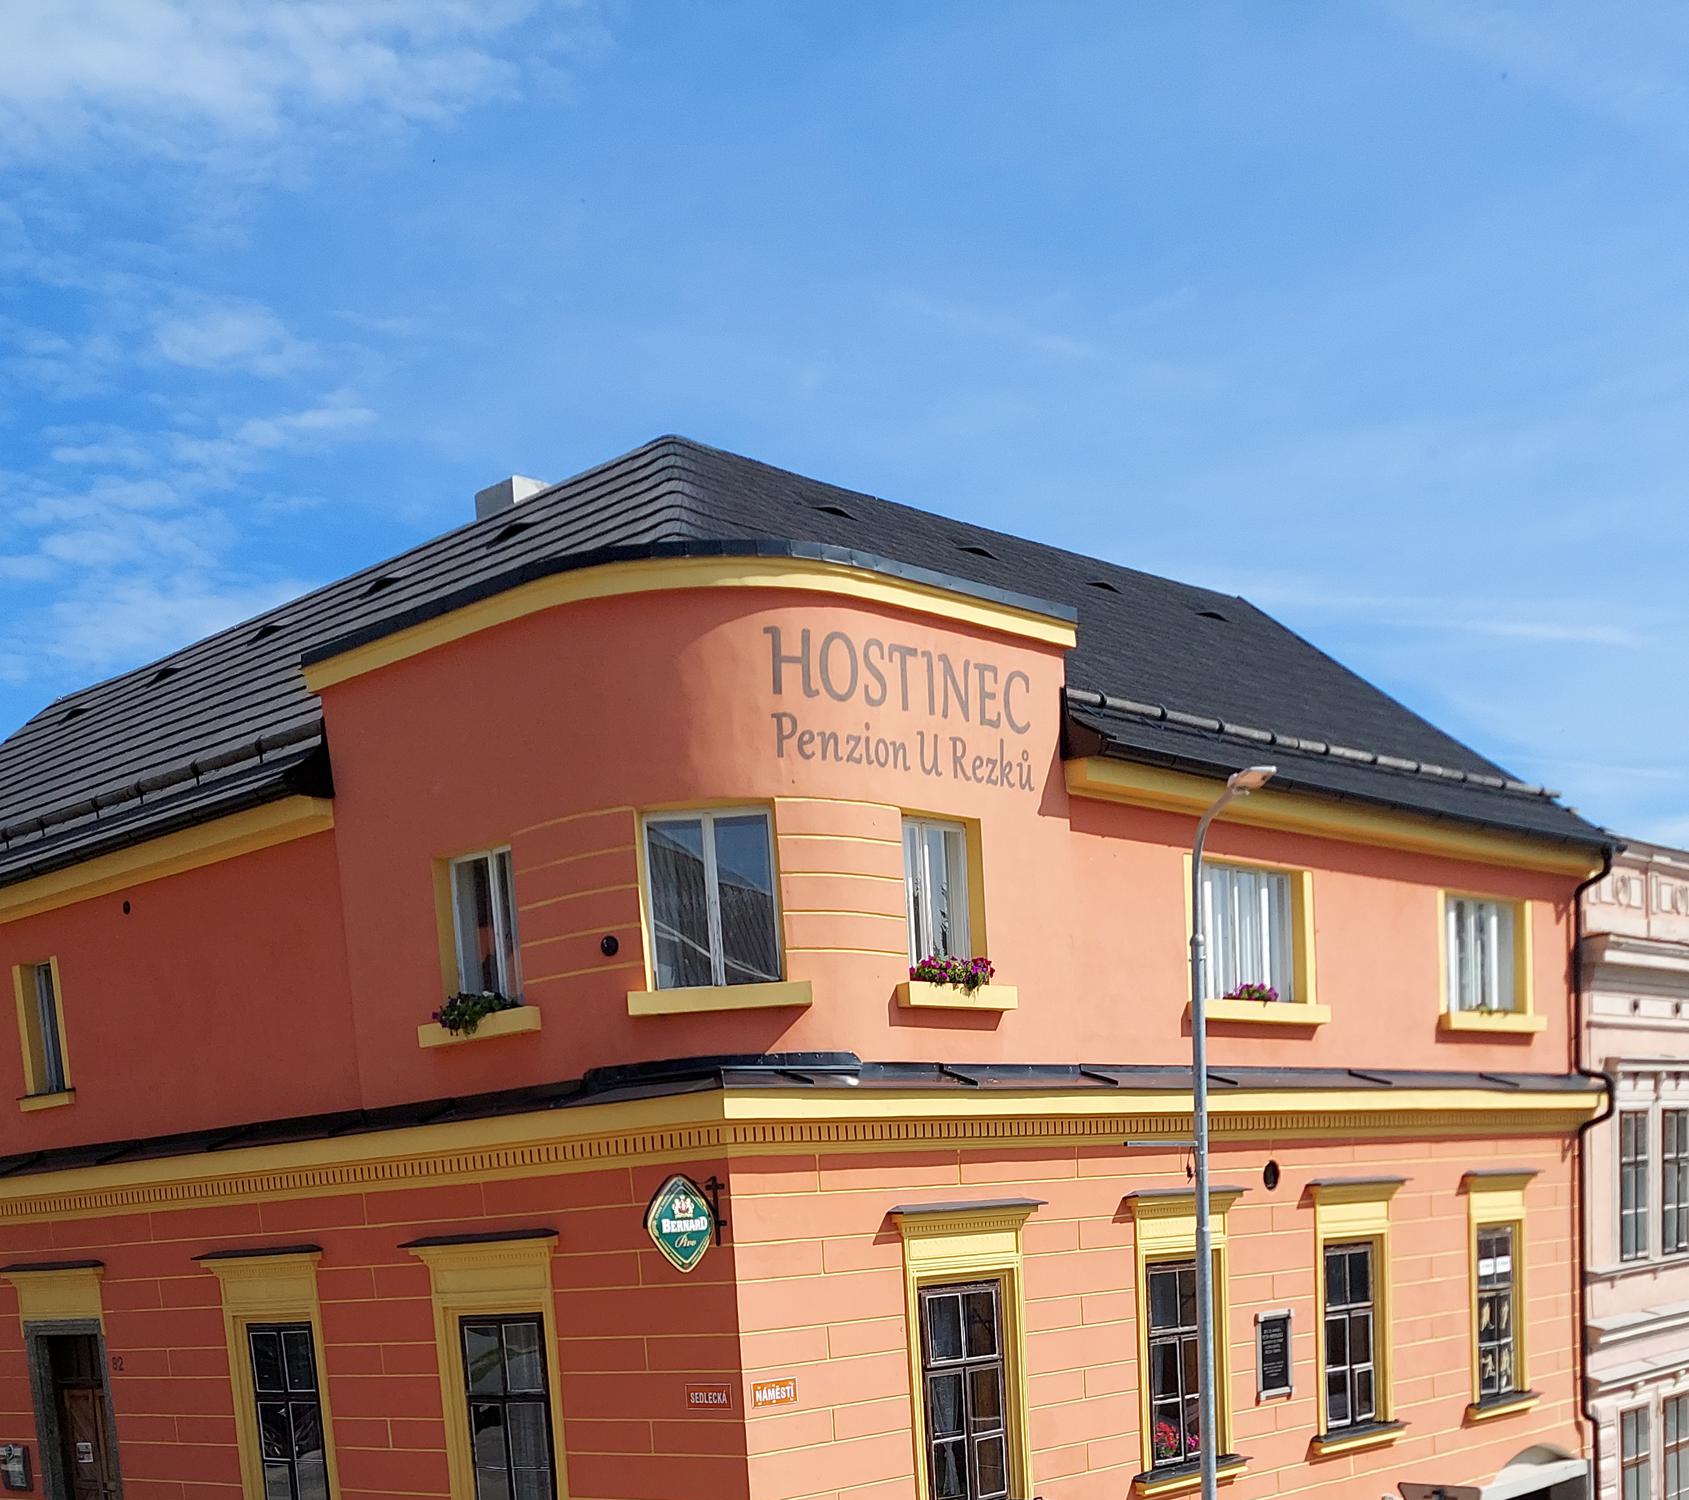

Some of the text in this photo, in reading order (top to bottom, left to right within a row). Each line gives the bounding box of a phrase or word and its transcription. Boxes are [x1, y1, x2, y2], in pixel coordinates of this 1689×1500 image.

[763, 625, 1031, 735] HOSTINEC
[771, 711, 1035, 792] Penzion U Rezků
[661, 1216, 708, 1234] BERNARD
[690, 1389, 728, 1404] SEDLECKÁ
[755, 1383, 795, 1402] NÁMĚSTÍ
